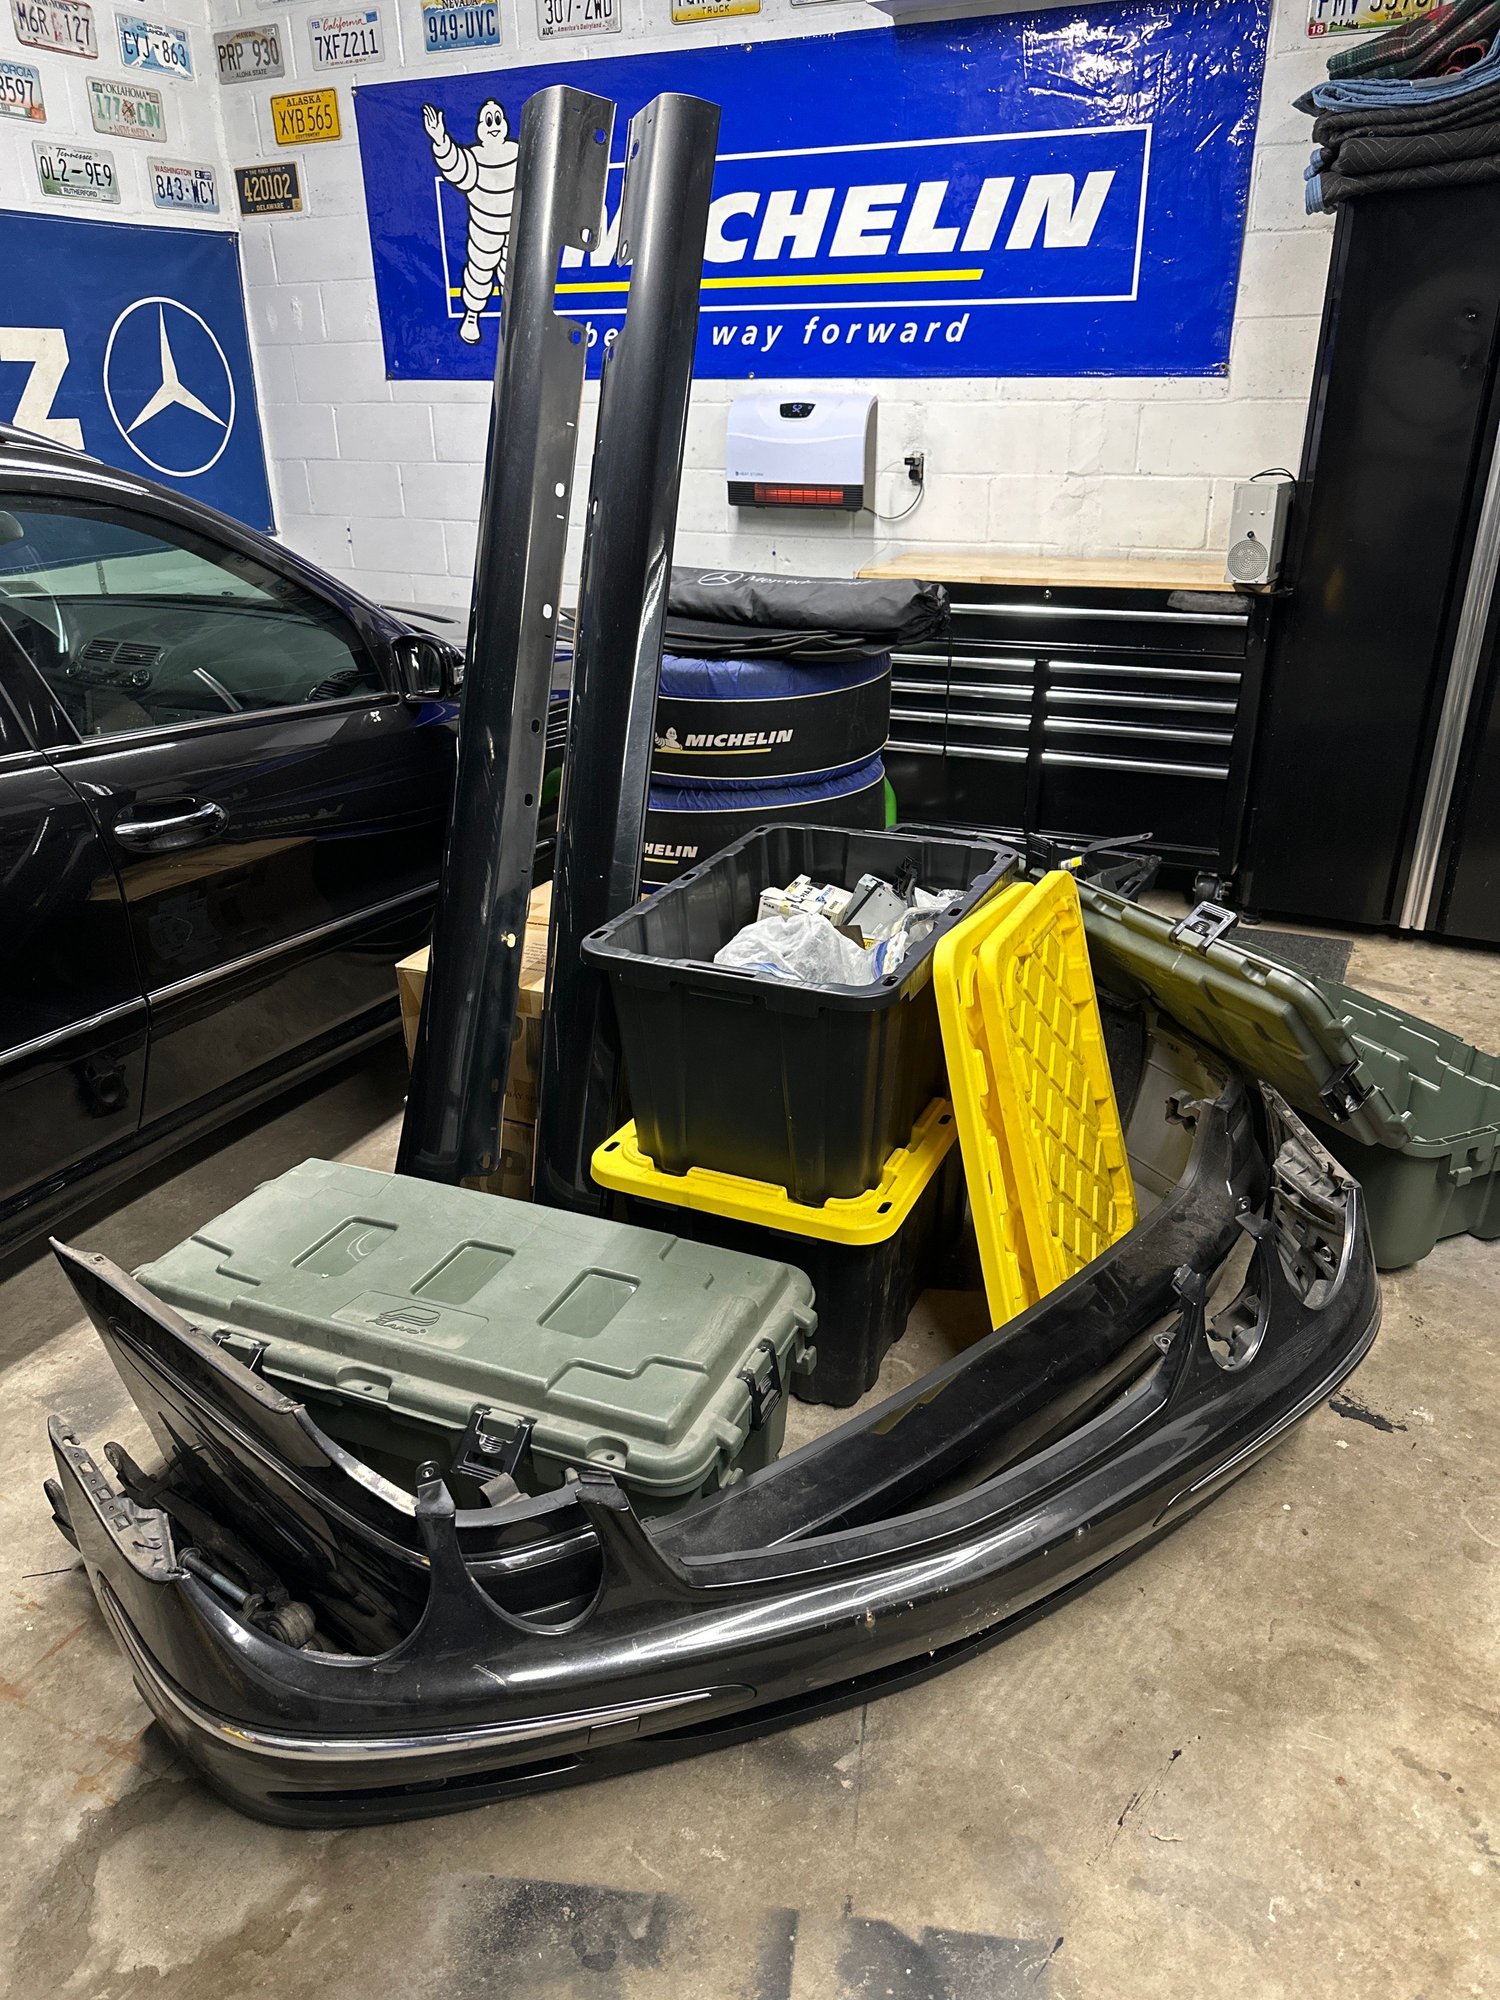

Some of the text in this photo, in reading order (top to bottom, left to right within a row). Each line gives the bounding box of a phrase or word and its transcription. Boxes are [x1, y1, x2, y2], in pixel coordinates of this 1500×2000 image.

[702, 4, 730, 15] TRUCK
[64, 13, 91, 46] 127
[137, 25, 171, 38] OKLAHOMA
[311, 16, 368, 33] FEB California
[542, 26, 554, 36] AUG
[1310, 25, 1324, 34] 18
[314, 29, 379, 61] 7XFZ211
[218, 37, 280, 72] PRP 930
[0, 63, 34, 79] ORGIA
[105, 83, 147, 100] OKLAHOMA
[96, 94, 121, 121] 177
[287, 94, 322, 107] ALASKA
[279, 104, 333, 135] XYB 565
[55, 147, 93, 160] Tennessee
[154, 165, 192, 176] WASHINGTON
[63, 187, 98, 198] RUTHERFORD
[244, 174, 293, 202] 420102
[256, 203, 285, 211] DELAWARE
[560, 168, 1115, 268] CHELIN
[712, 312, 970, 352] way forward
[685, 729, 794, 747] MICHELIN
[644, 842, 699, 858] HELIN
